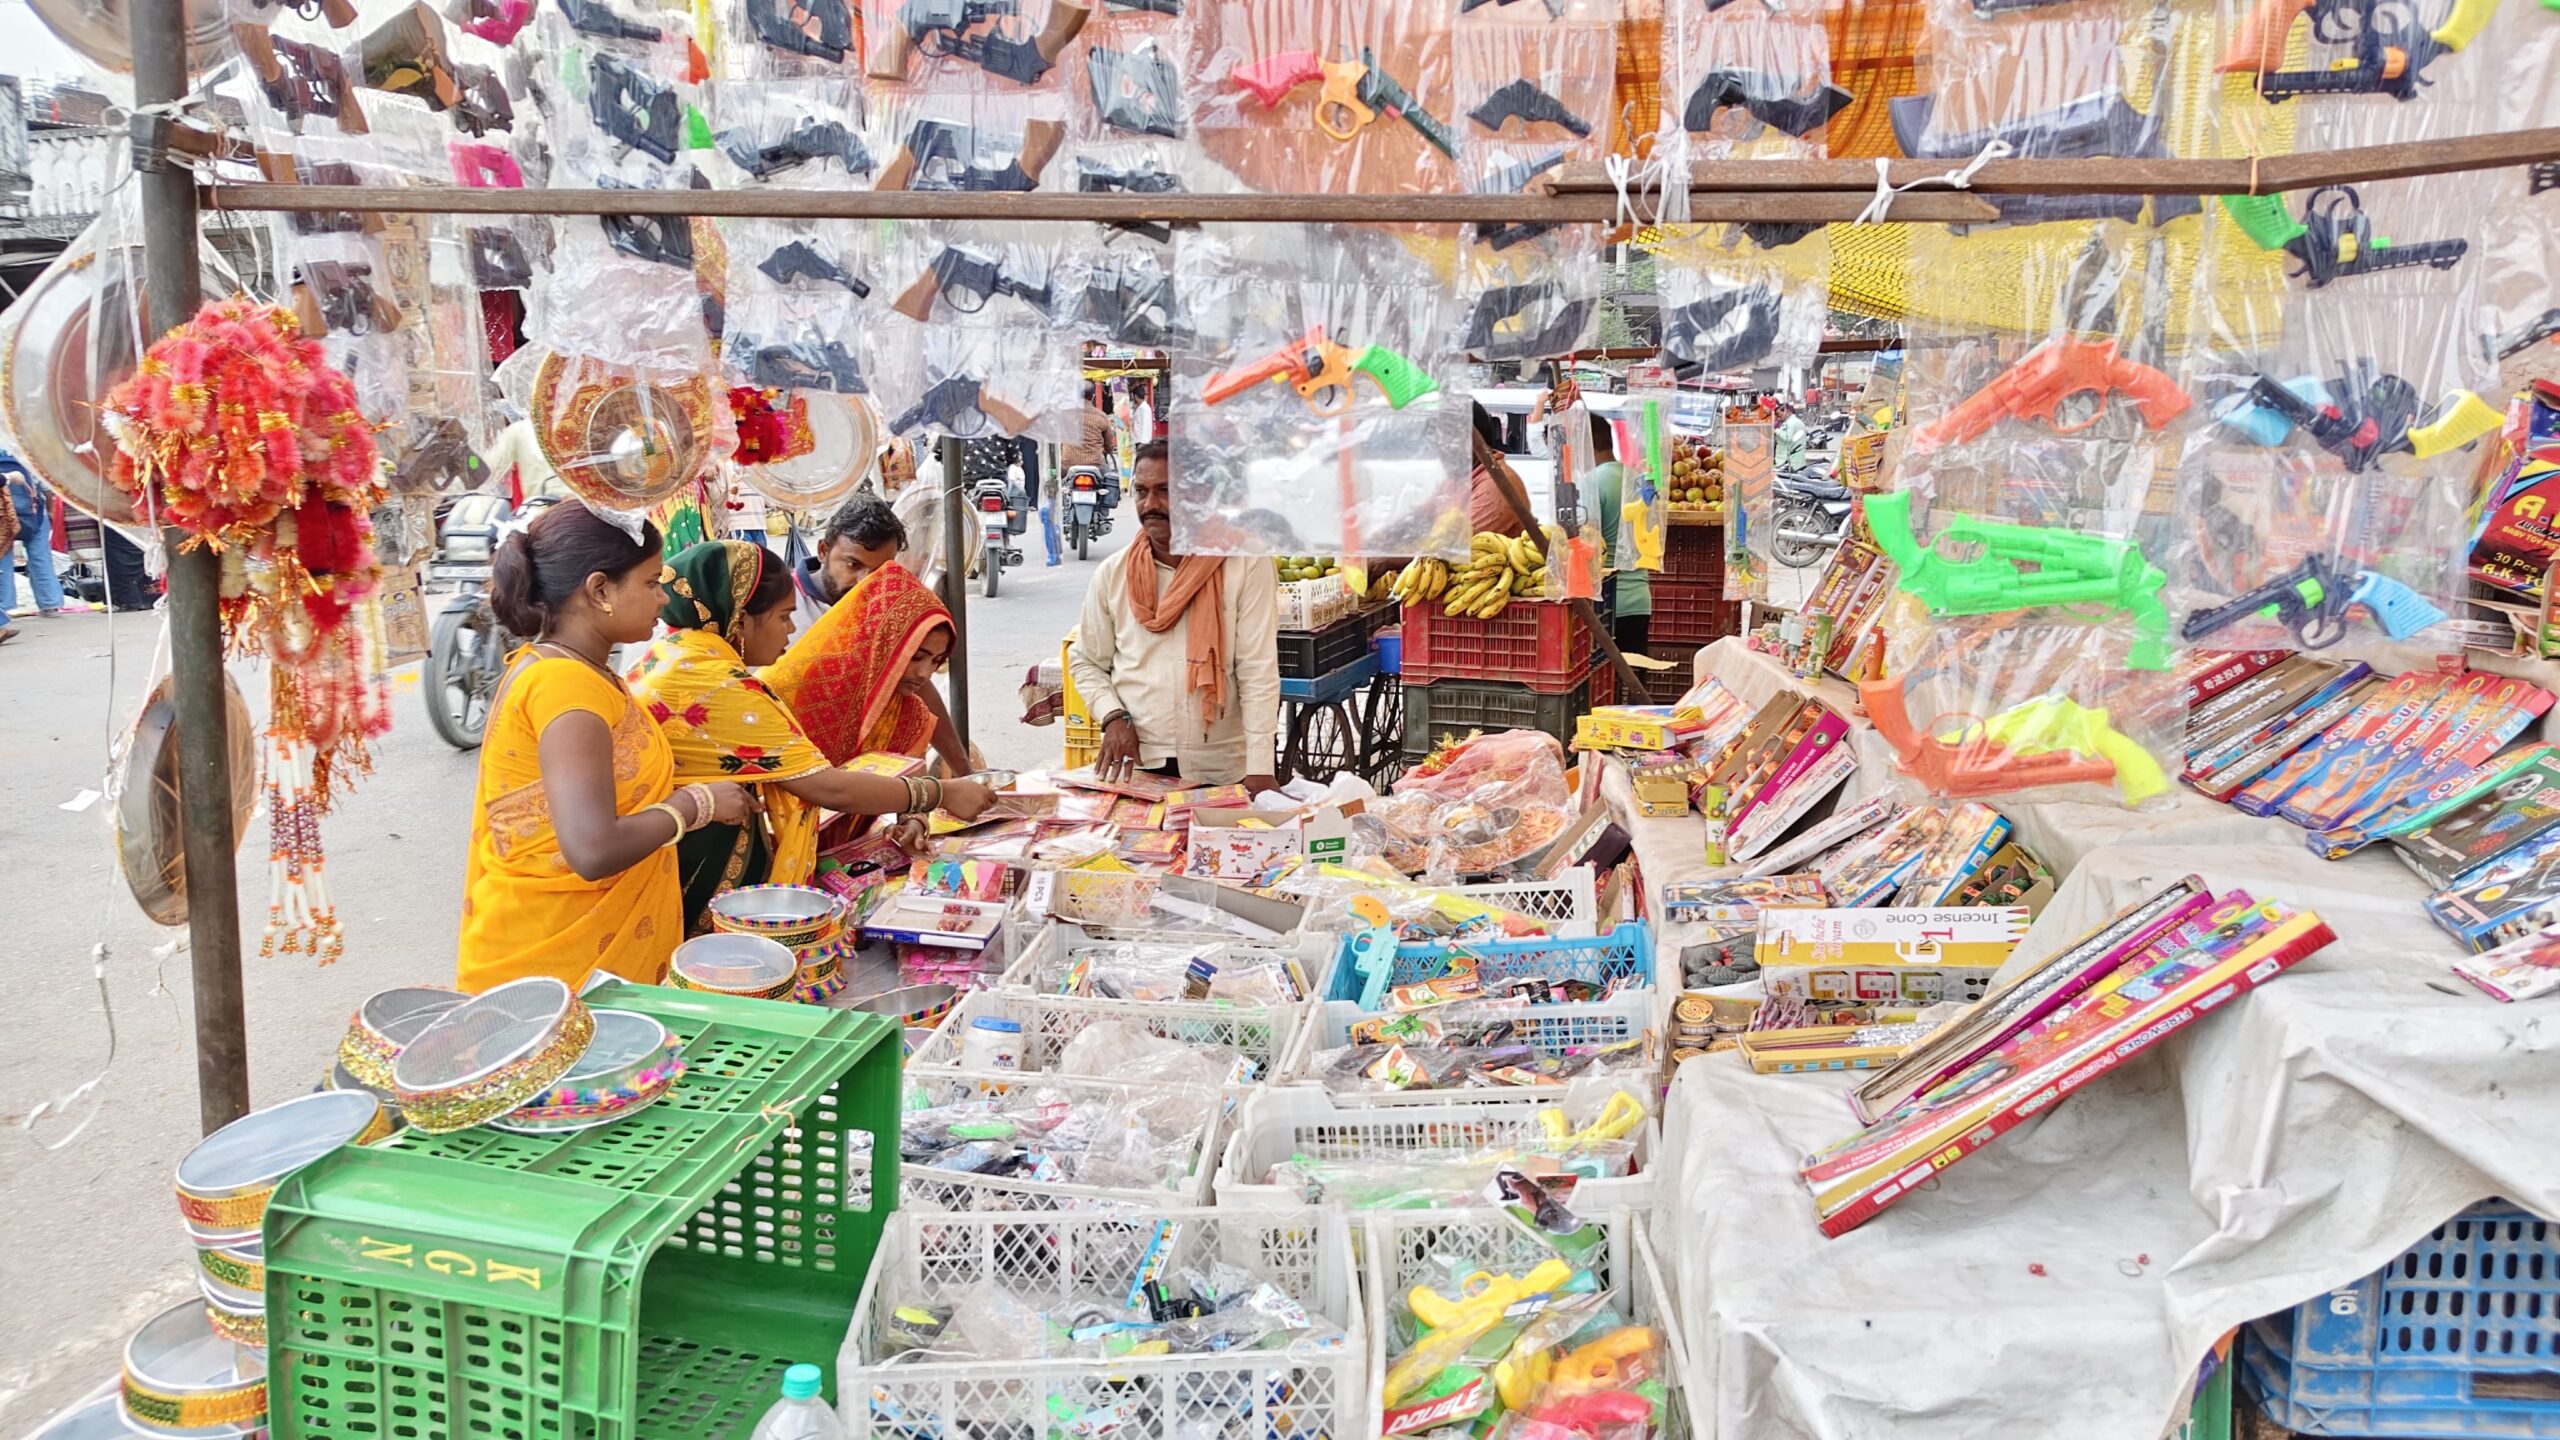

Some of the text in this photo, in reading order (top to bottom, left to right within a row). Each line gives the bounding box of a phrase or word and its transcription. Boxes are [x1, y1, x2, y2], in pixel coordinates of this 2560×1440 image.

[2494, 552, 2511, 564] 30
[2366, 700, 2422, 746] COLOUR
[2393, 705, 2449, 754] COLOUR
[2423, 716, 2482, 765] COLOUR
[1886, 912, 1998, 925] Incense Cone
[2014, 1008, 2195, 1117] FIREWORKS FACTORY INDIA
[1386, 1386, 1484, 1434] DOUBLE
